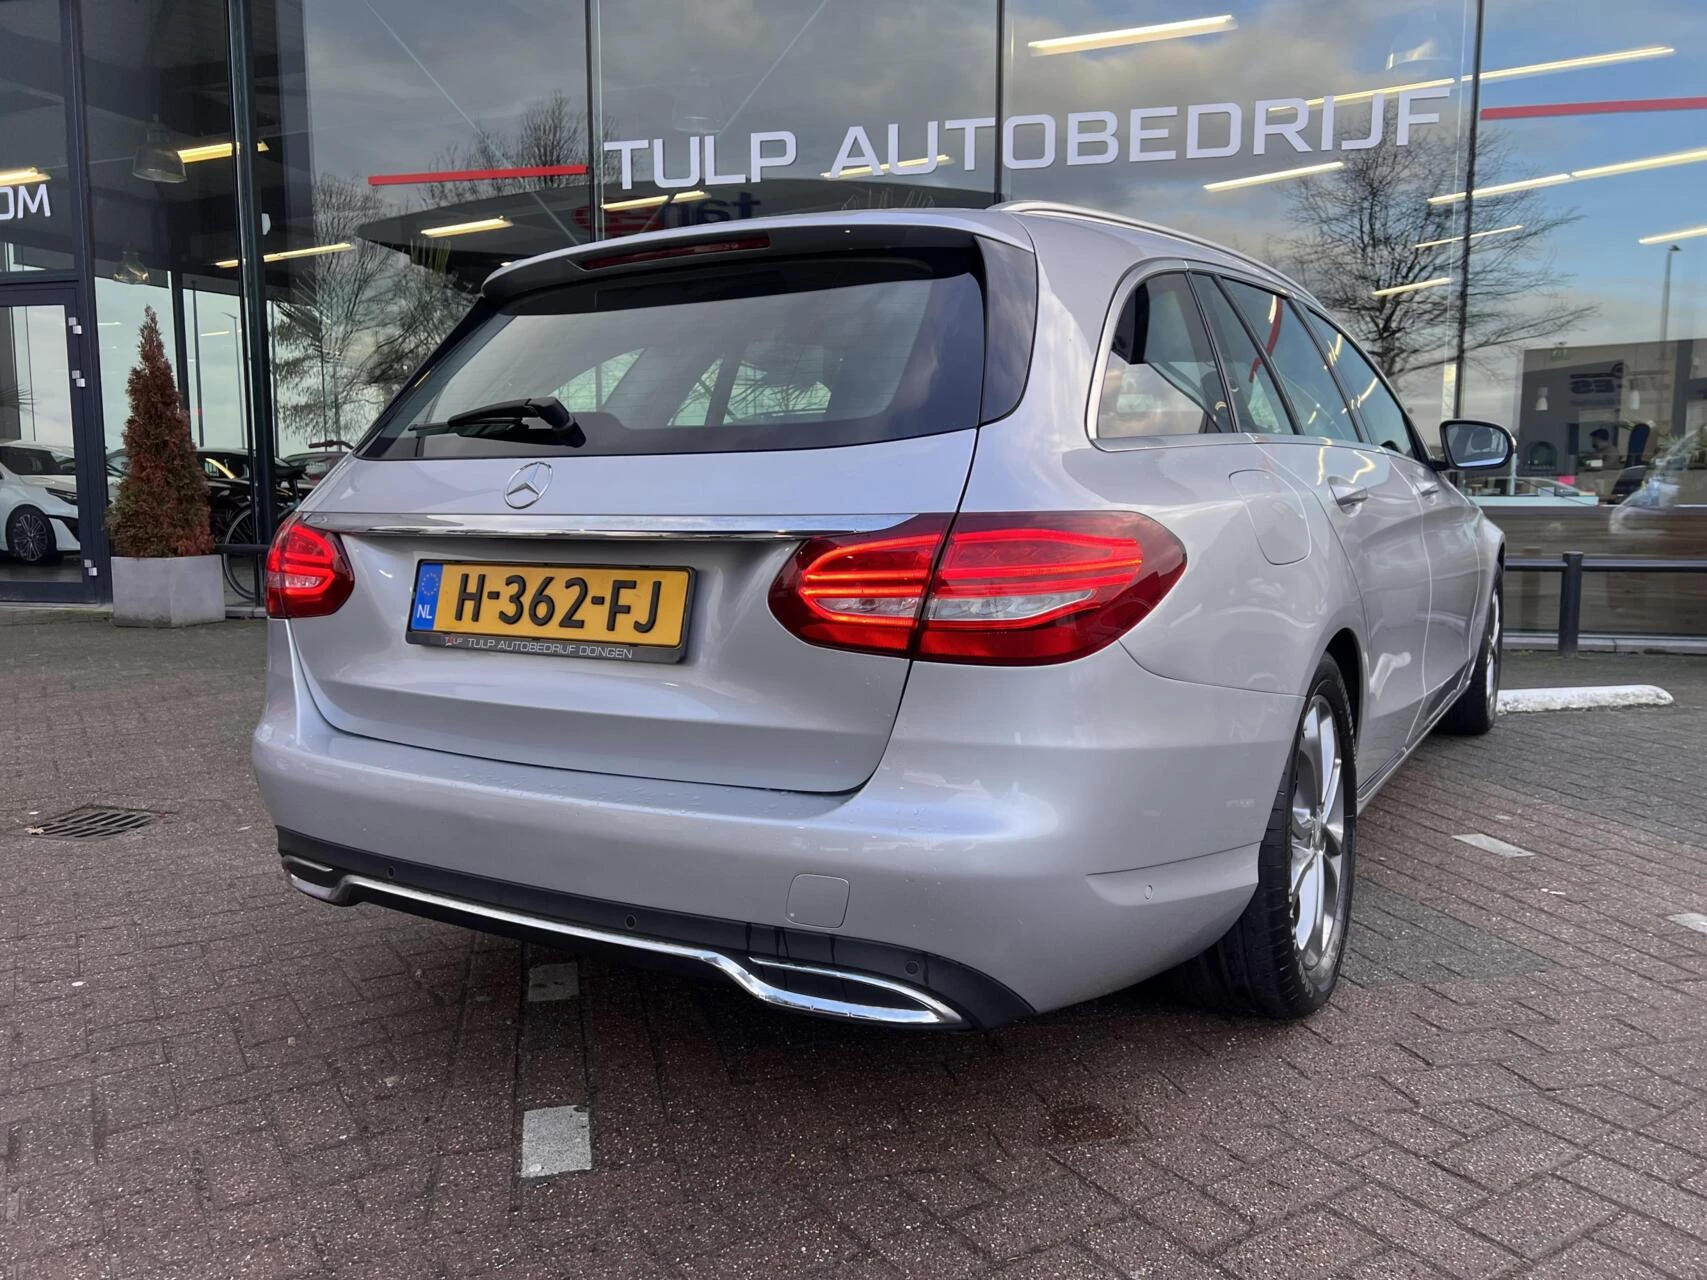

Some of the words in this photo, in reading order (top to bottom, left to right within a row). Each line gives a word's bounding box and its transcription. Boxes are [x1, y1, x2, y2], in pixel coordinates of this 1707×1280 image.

[603, 131, 797, 190] TULP
[830, 88, 1450, 178] AUTOBEDRIJF
[416, 603, 433, 619] NL
[455, 573, 662, 633] H-362-FJ
[467, 638, 495, 649] TULP
[498, 641, 576, 656] AUTOBEDRIJF
[579, 646, 633, 660] DONGEN
